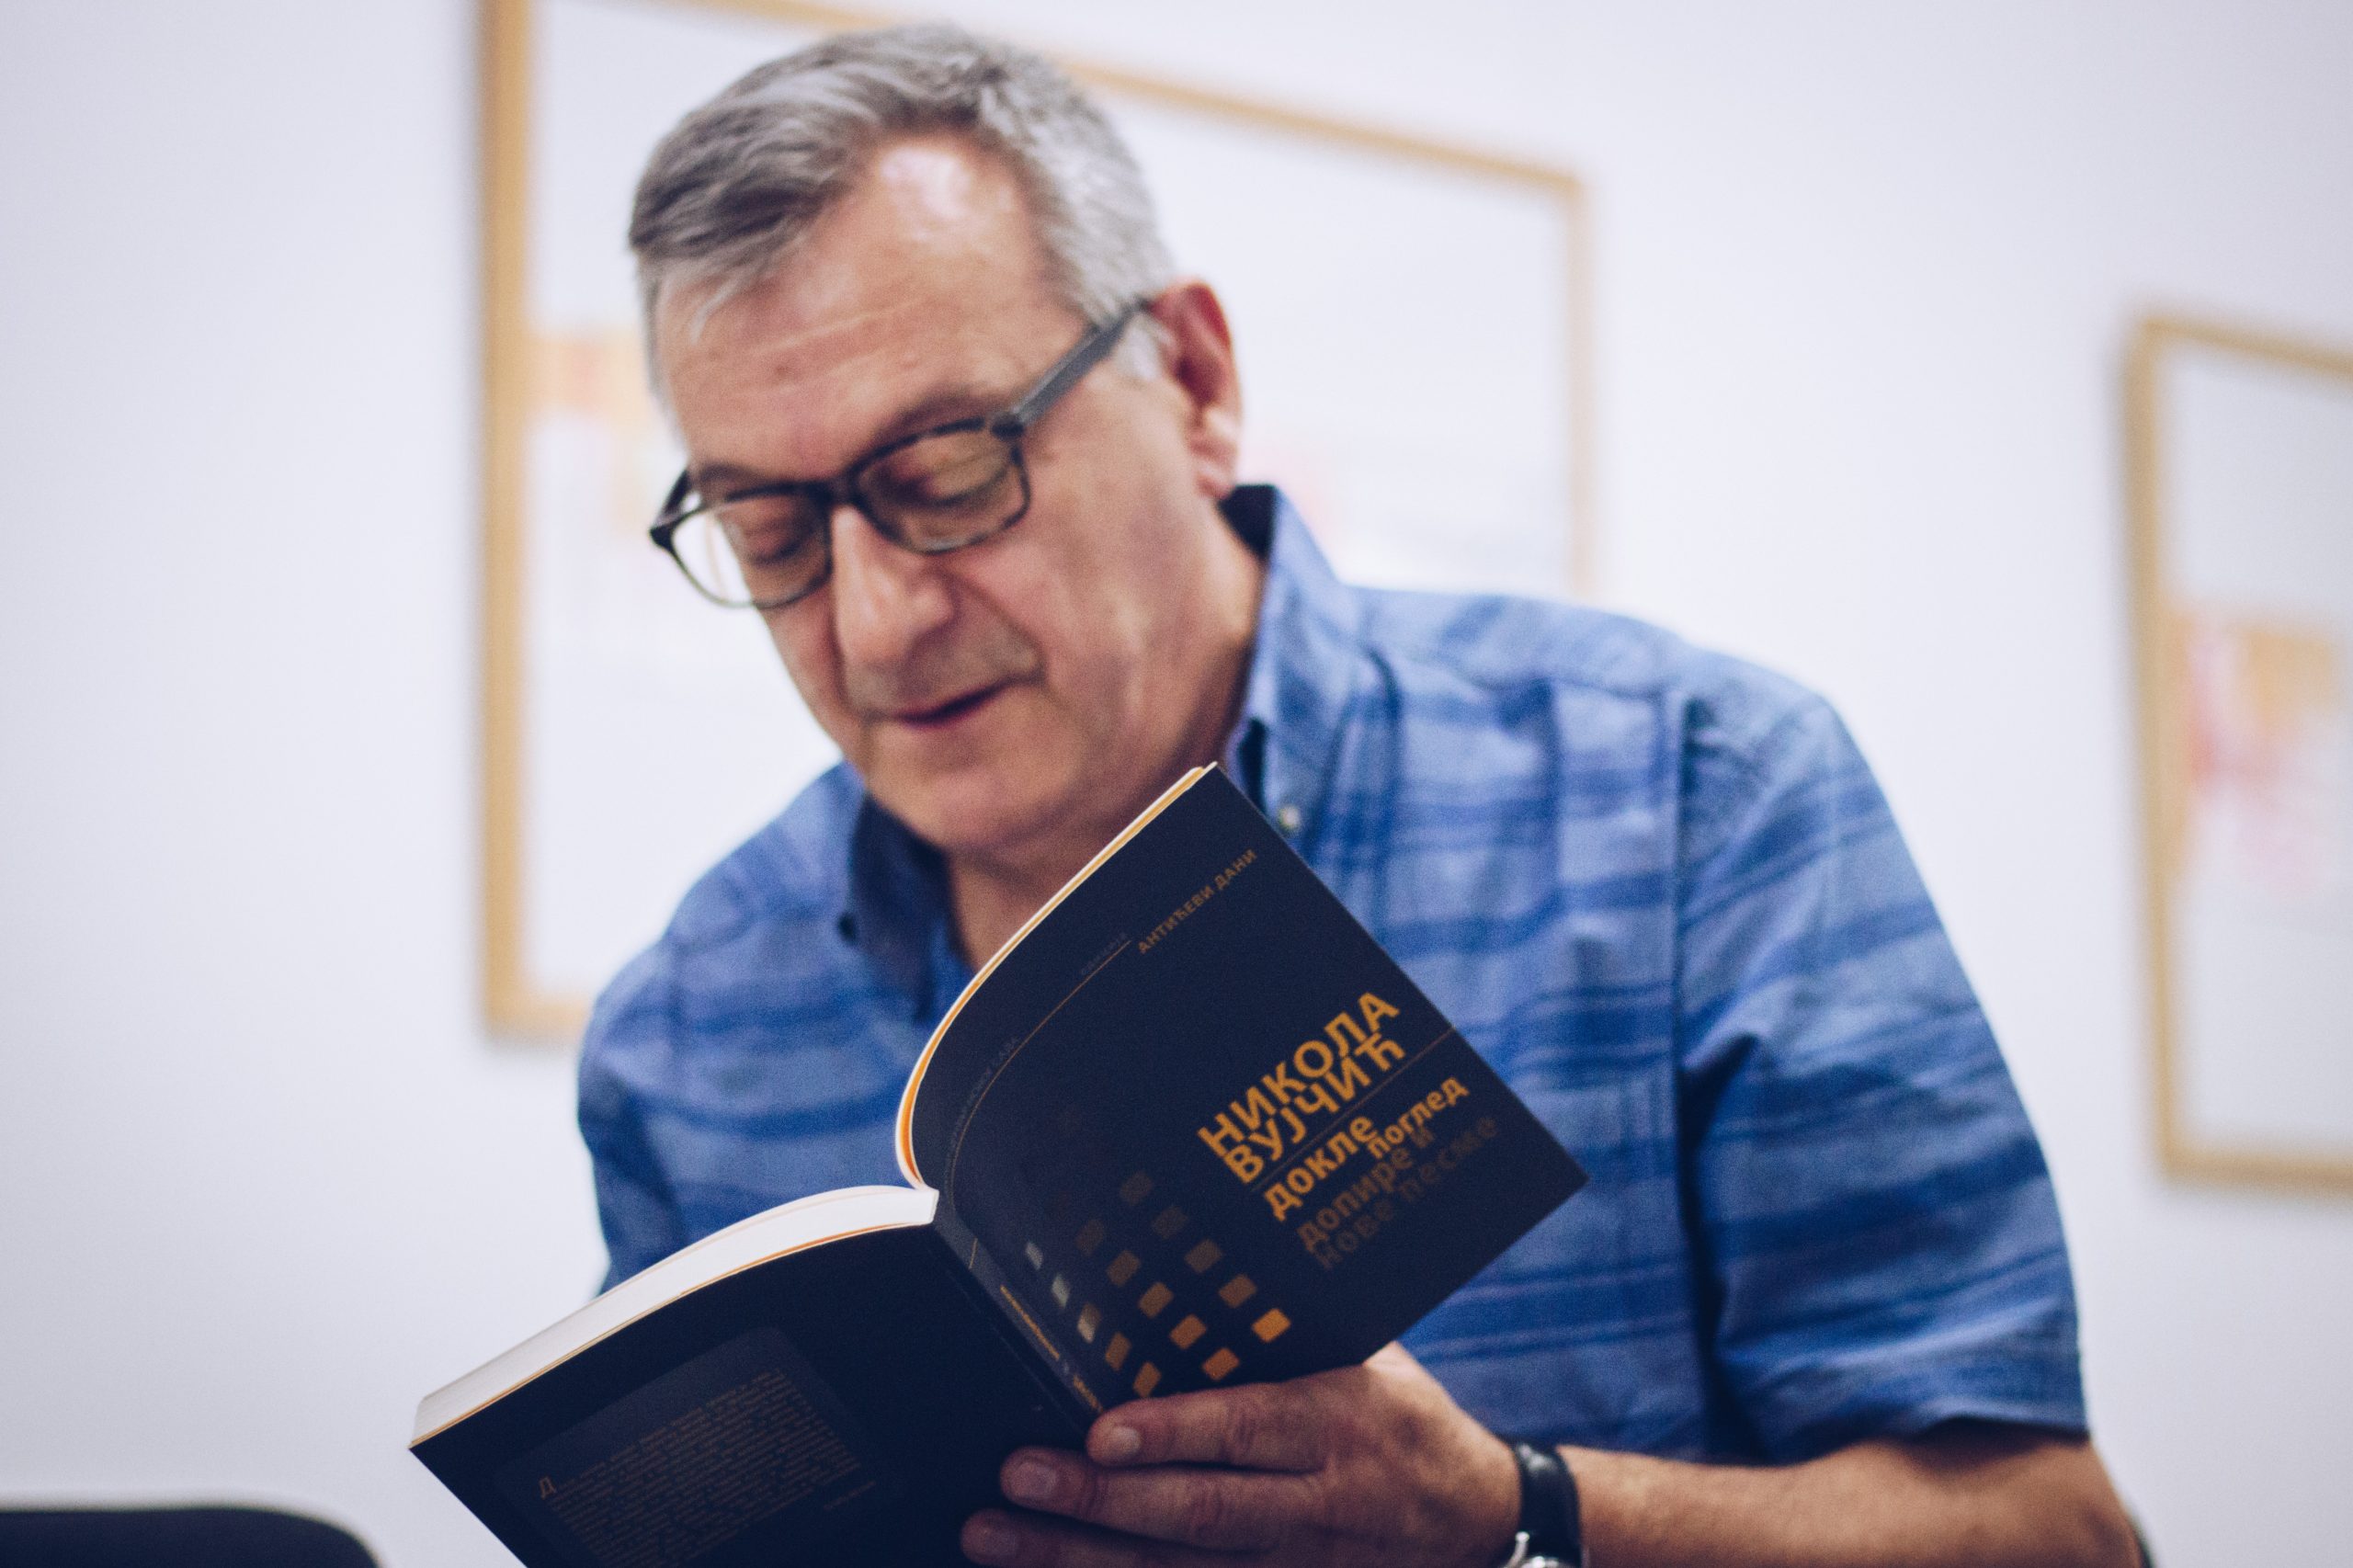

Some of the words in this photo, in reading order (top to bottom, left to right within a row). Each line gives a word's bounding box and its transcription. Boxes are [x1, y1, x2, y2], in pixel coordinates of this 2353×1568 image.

[1214, 848, 1258, 891] ДАНИ
[1197, 992, 1401, 1158] НИКОЛА
[1222, 1032, 1406, 1184] ВУЈЧИЋ
[1366, 1076, 1470, 1160] поглед
[1263, 1116, 1375, 1222] докле
[1296, 1145, 1414, 1252] допире
[1312, 1199, 1395, 1270] нове
[1398, 1117, 1499, 1202] песме
